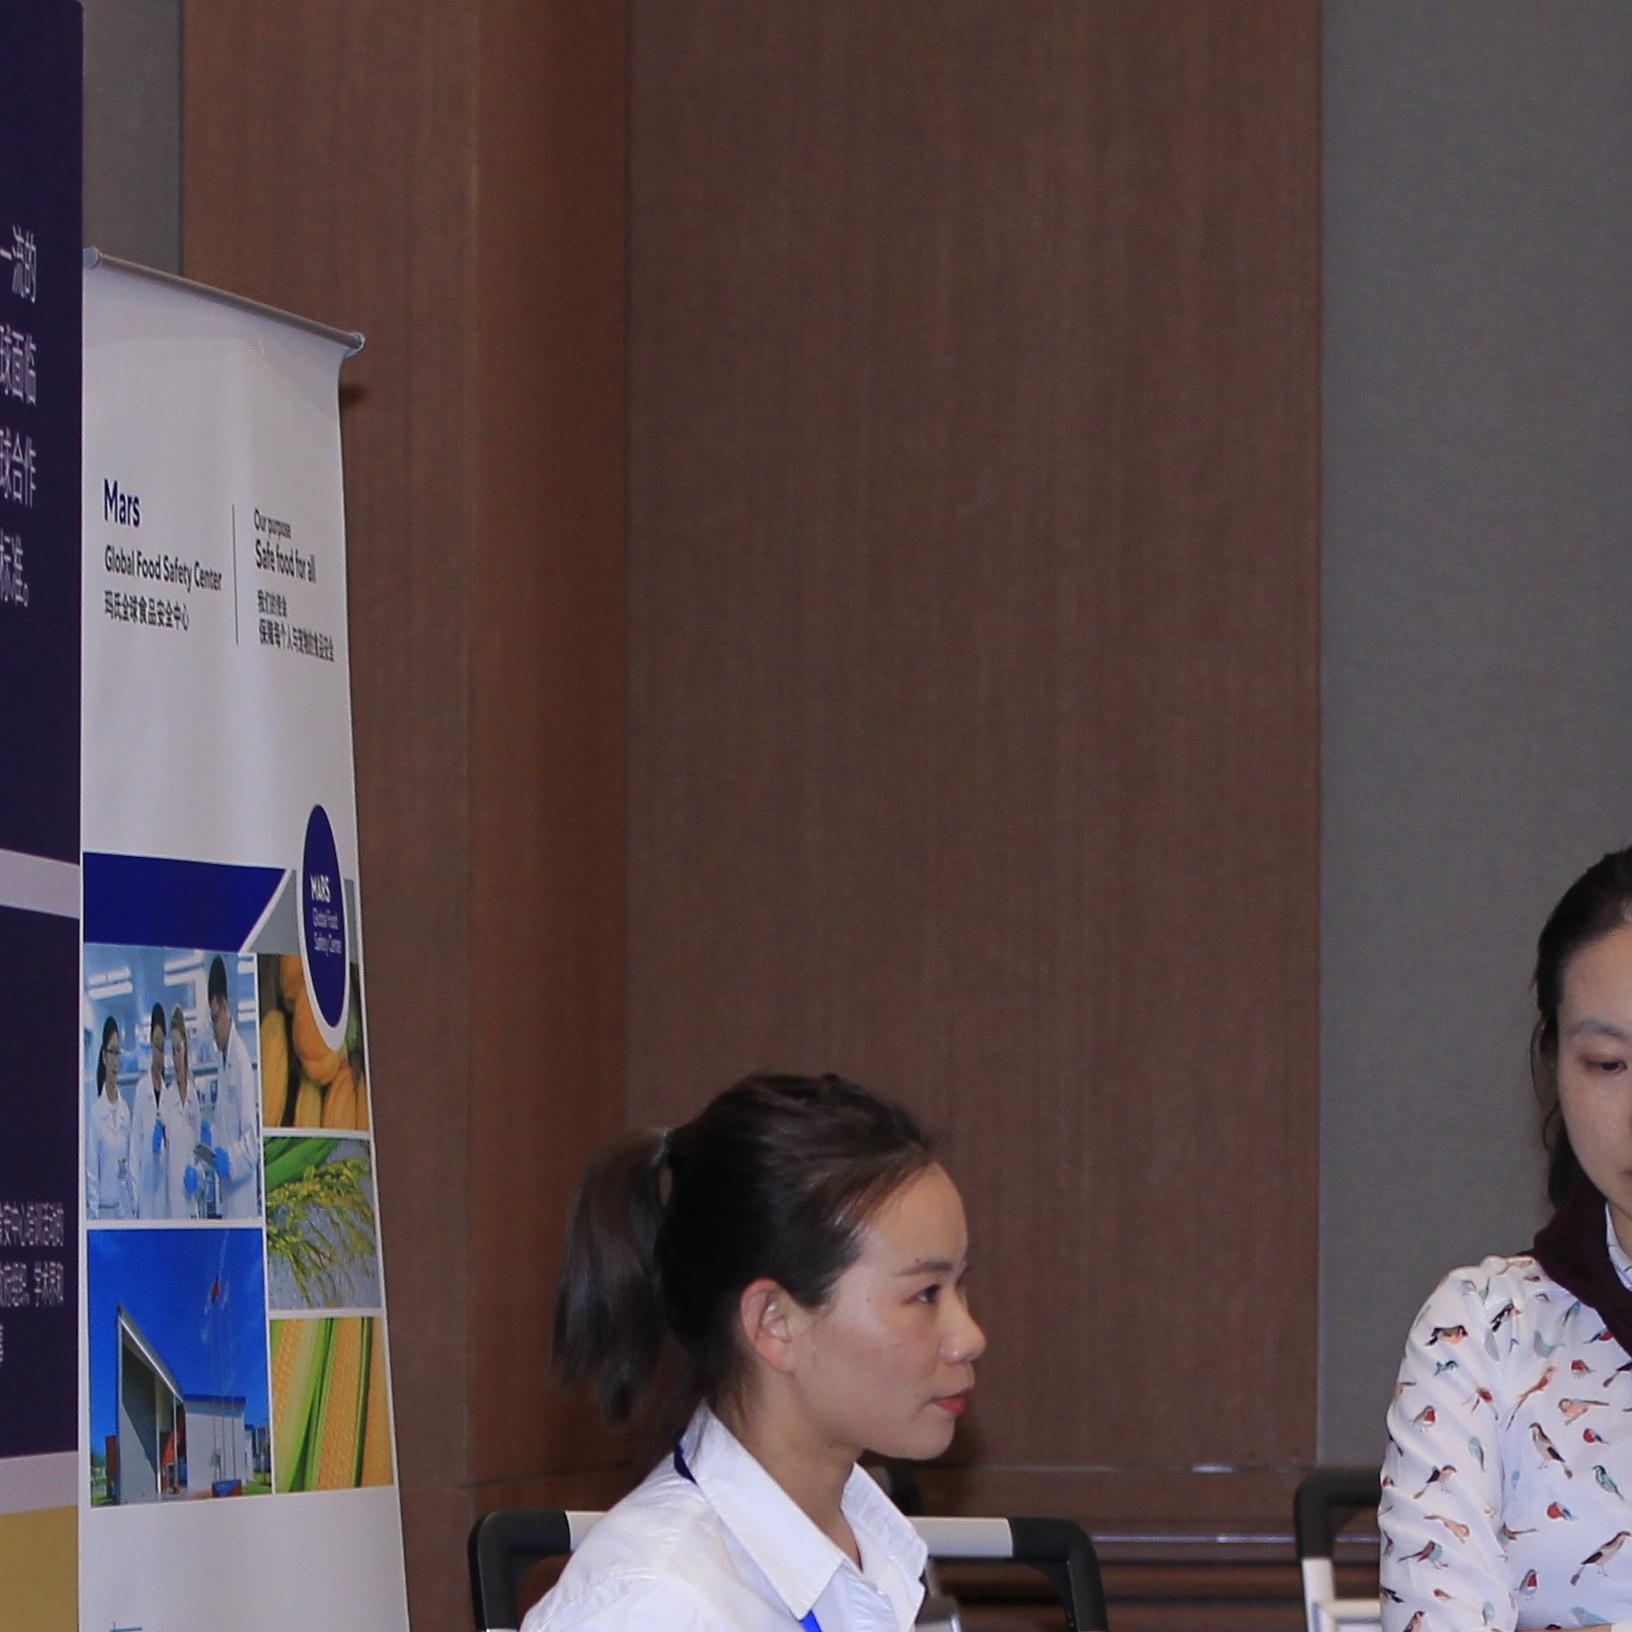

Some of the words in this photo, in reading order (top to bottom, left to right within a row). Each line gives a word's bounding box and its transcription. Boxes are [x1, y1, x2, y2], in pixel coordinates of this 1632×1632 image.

[104, 478, 141, 528] Mars
[105, 545, 135, 576] Global
[136, 551, 162, 581] Food
[163, 556, 193, 593] Safety
[193, 561, 222, 592] Center
[255, 538, 275, 572] Safe
[276, 542, 294, 577] food
[295, 549, 305, 580] for
